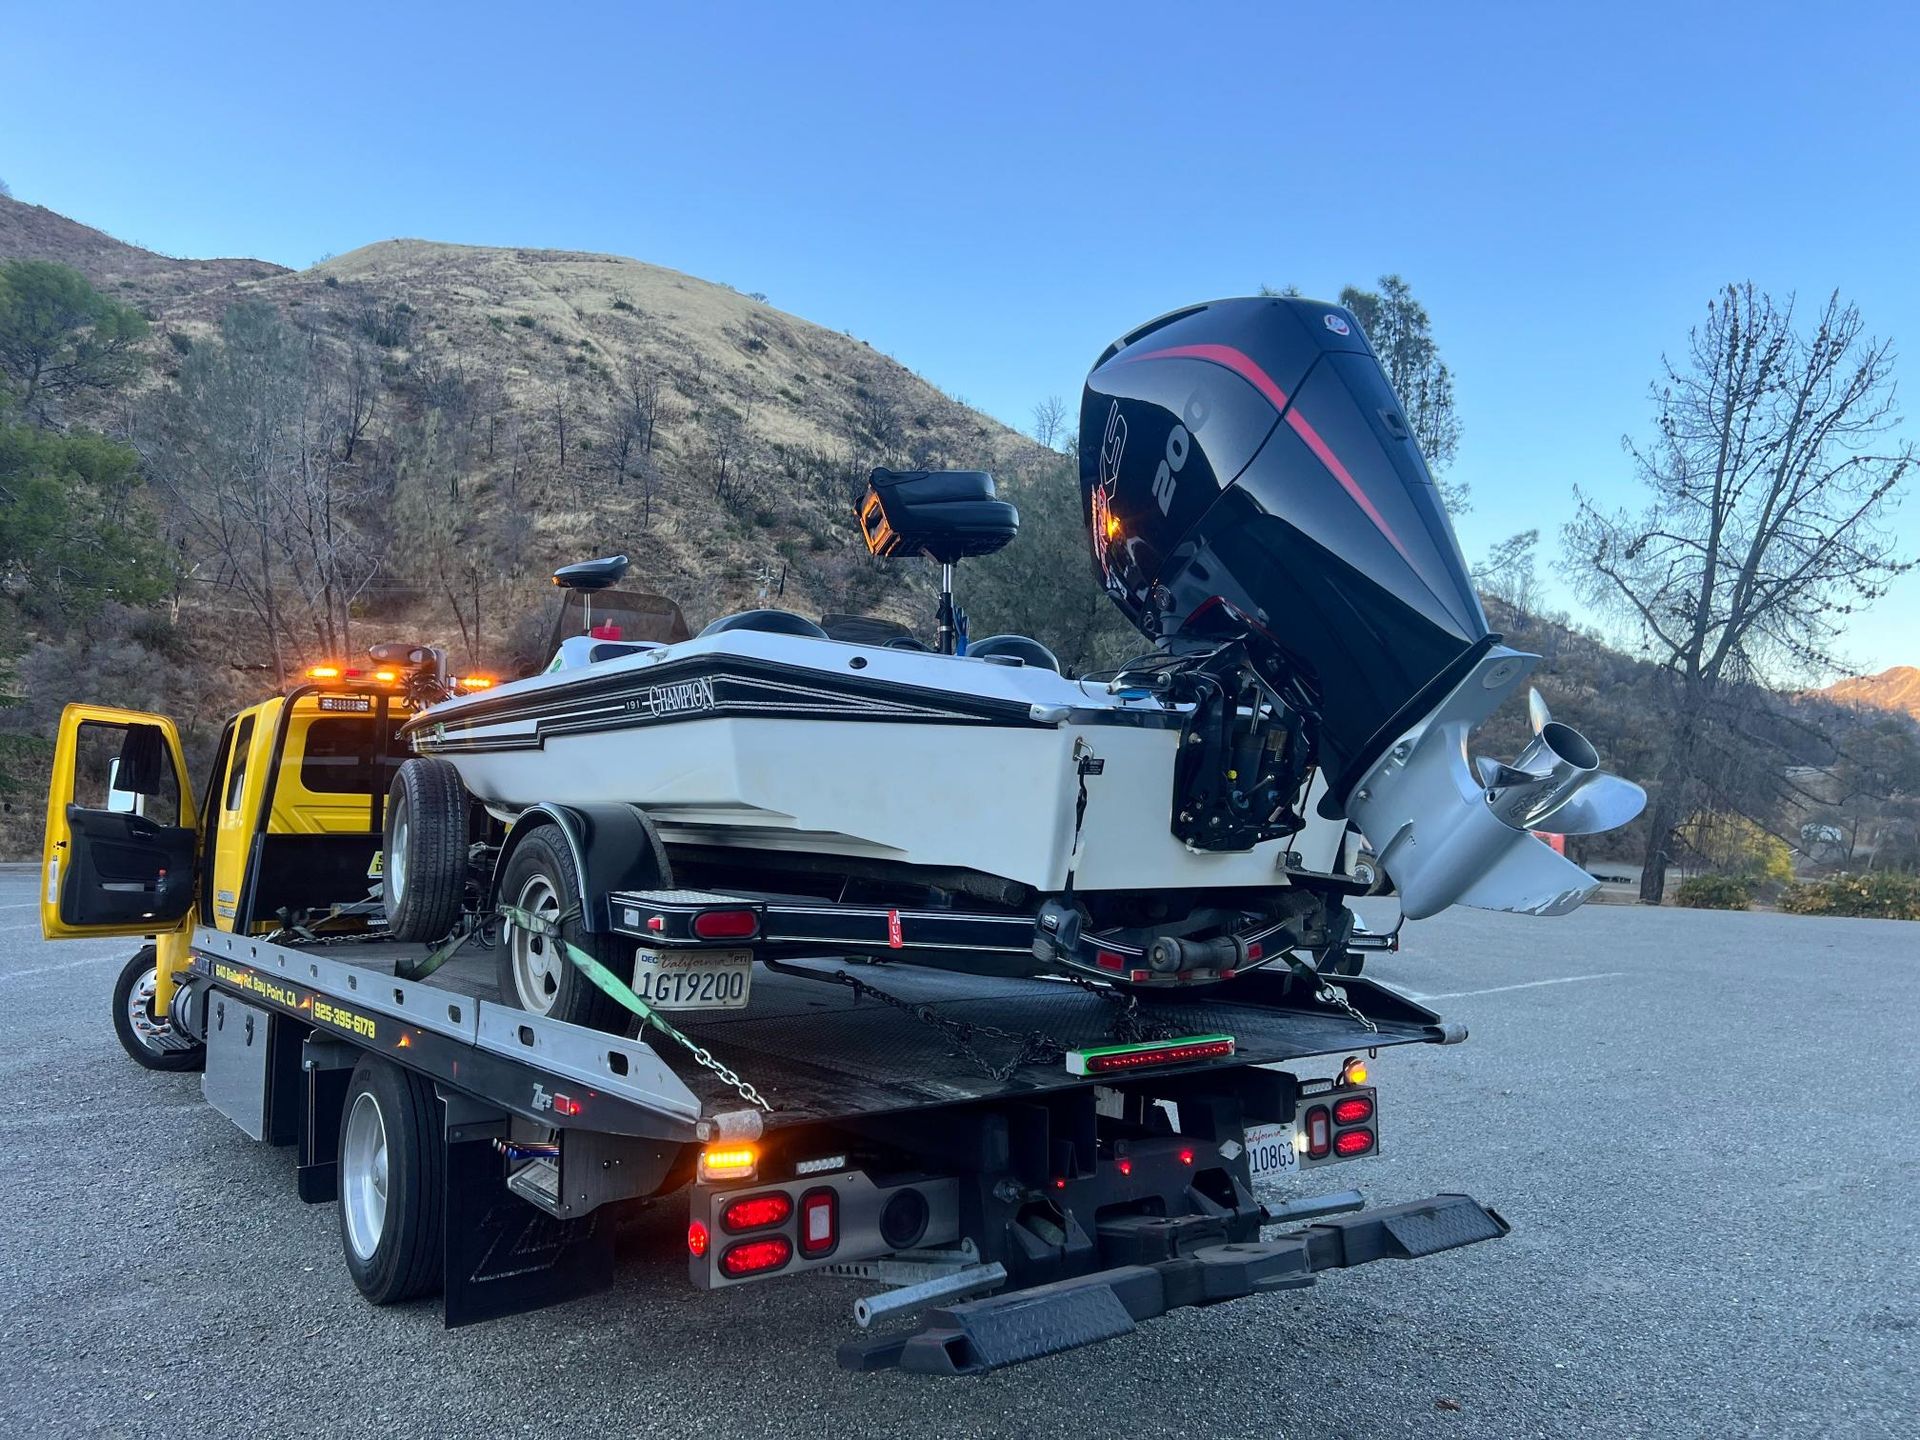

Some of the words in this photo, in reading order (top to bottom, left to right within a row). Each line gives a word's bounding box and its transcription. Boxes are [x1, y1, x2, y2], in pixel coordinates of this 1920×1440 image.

[1152, 388, 1211, 517] 200
[626, 700, 640, 710] 191
[649, 676, 715, 716] CHAMPION
[641, 954, 658, 964] DEC
[639, 972, 743, 1002] 1GT9200
[254, 976, 266, 997] Bay
[286, 990, 297, 1008] CA
[314, 1001, 376, 1039] 925-395-6178
